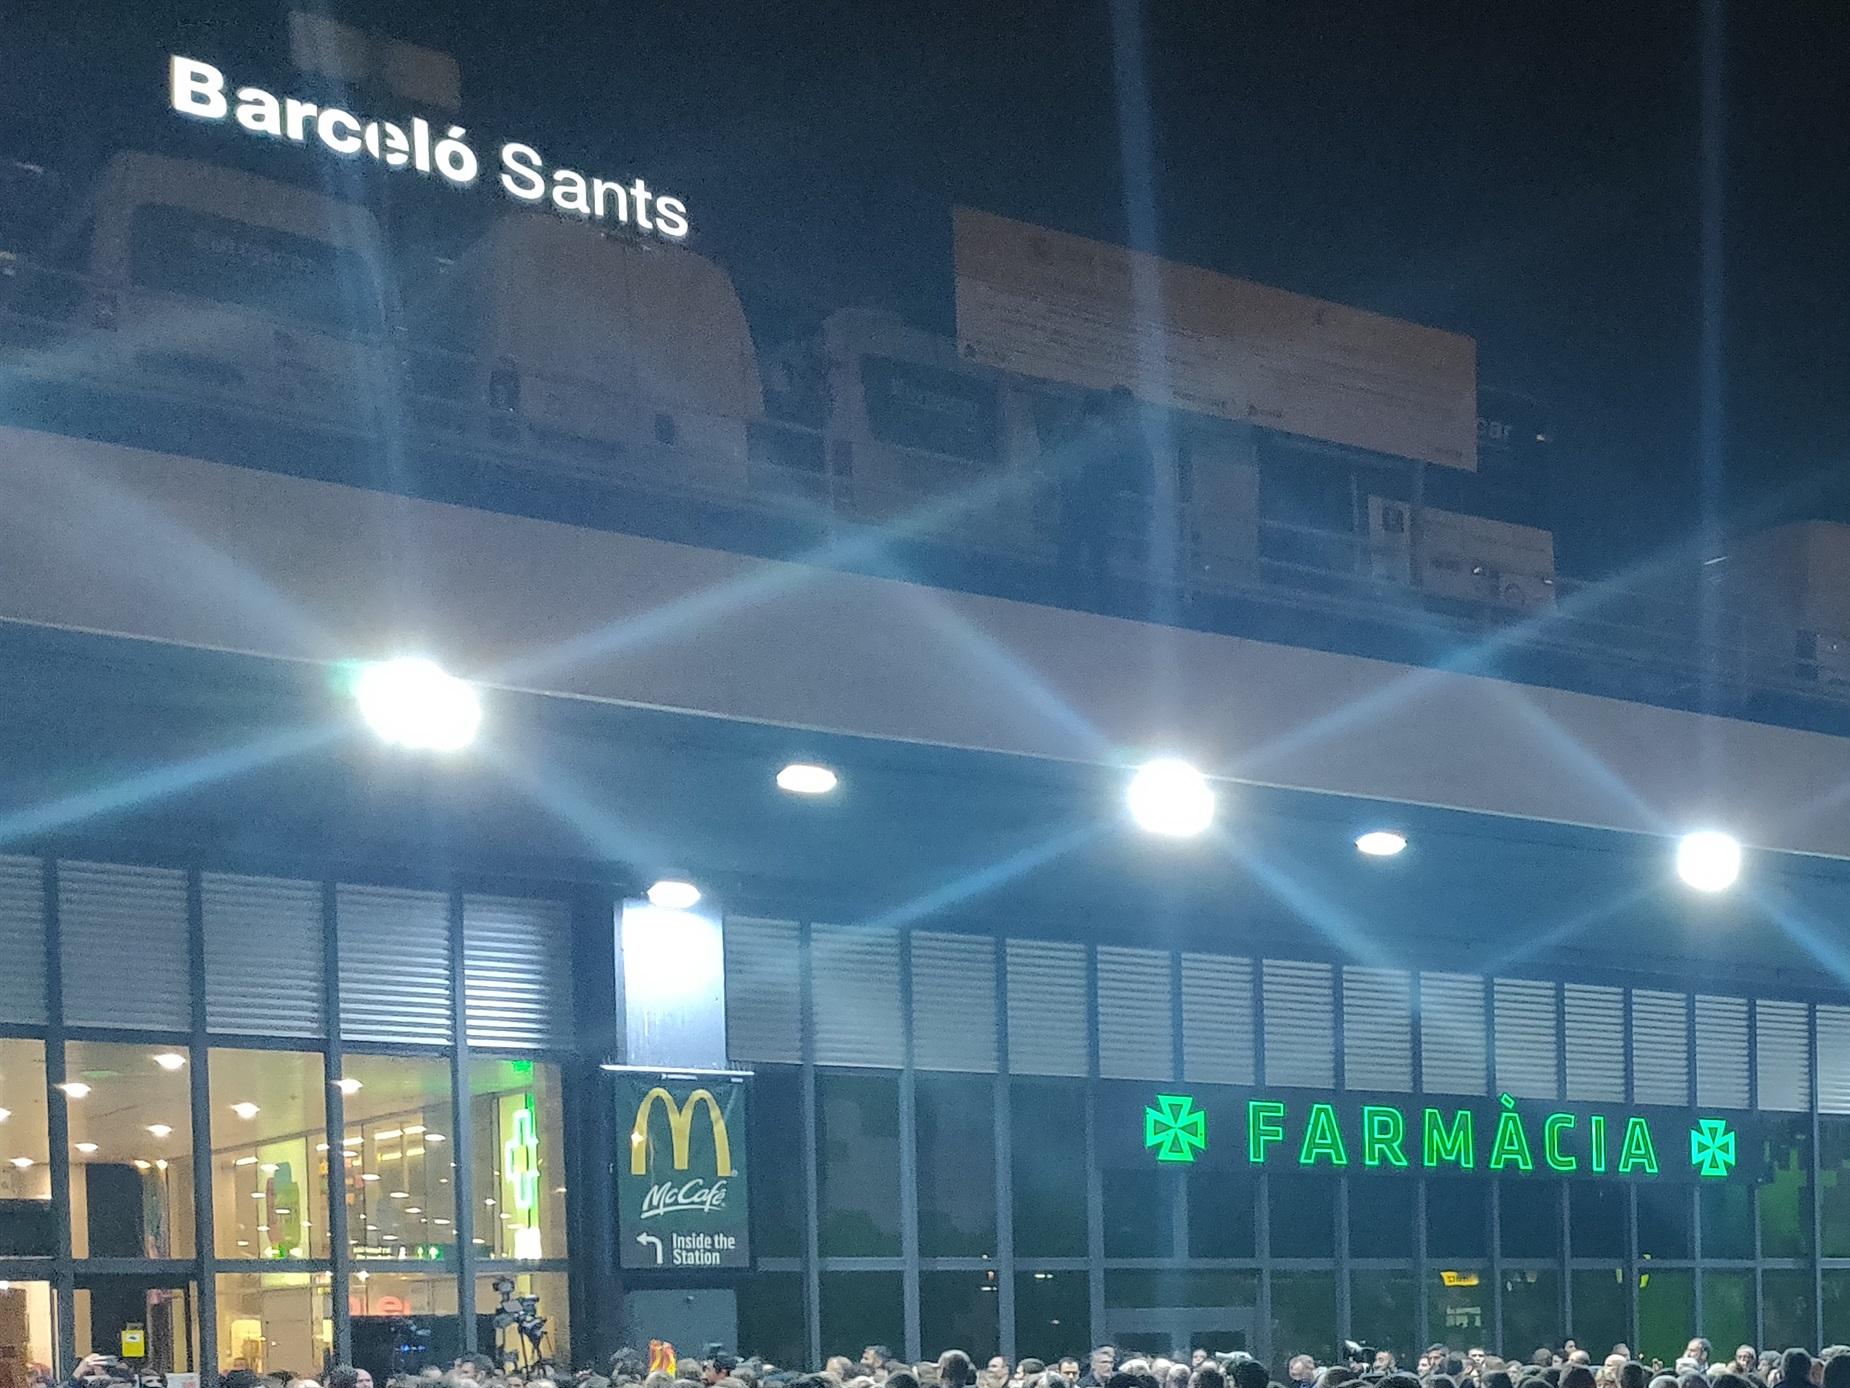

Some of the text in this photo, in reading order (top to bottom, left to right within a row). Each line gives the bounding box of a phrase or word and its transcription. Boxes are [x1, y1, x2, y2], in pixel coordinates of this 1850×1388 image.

[172, 56, 690, 237] Barceló Sants
[1248, 1093, 1659, 1174] FARMÀCIA
[641, 1178, 728, 1216] McCafé
[672, 1232, 736, 1250] Inside the
[672, 1248, 721, 1266] Station
